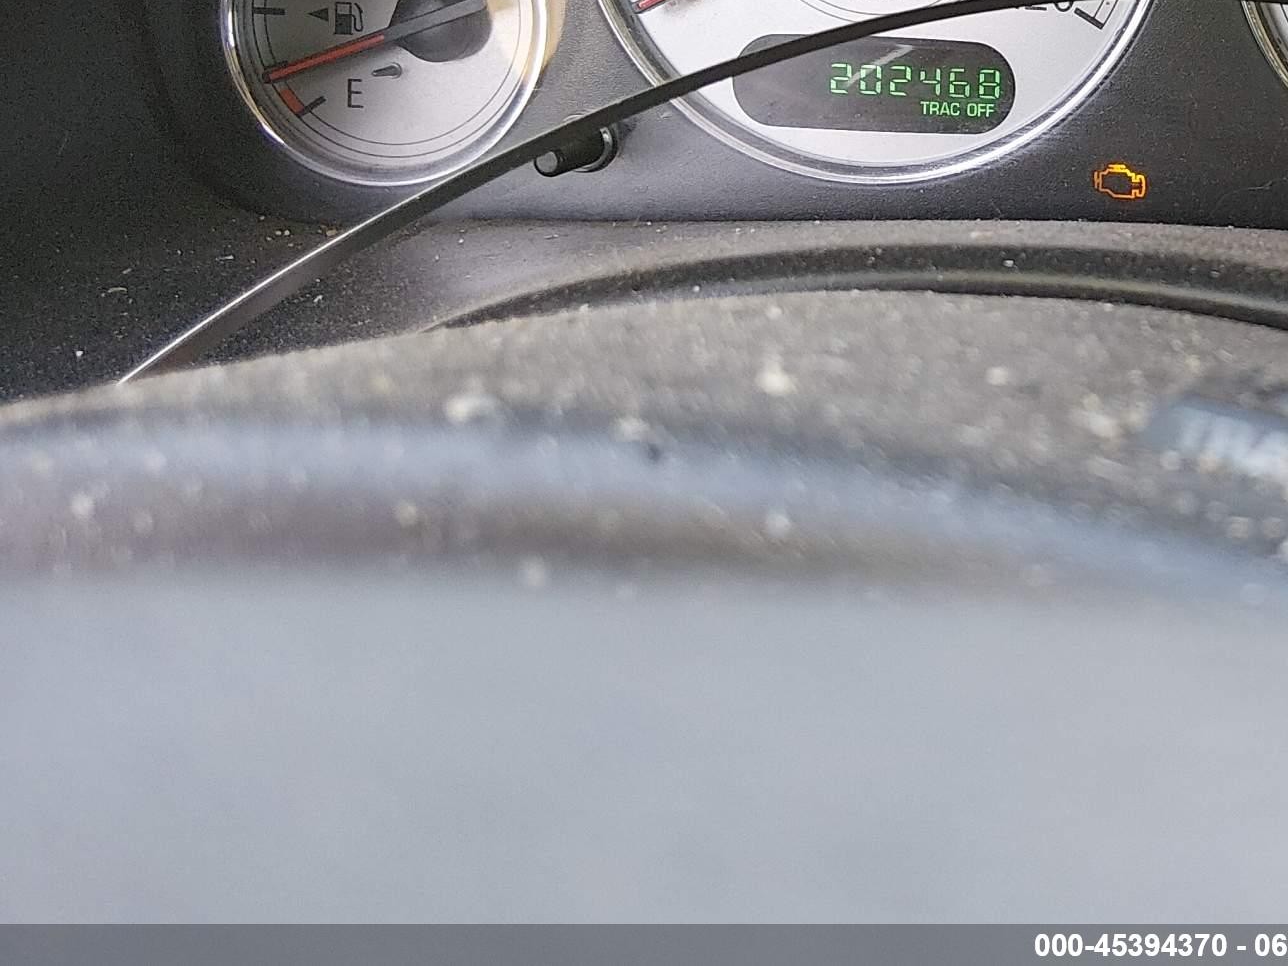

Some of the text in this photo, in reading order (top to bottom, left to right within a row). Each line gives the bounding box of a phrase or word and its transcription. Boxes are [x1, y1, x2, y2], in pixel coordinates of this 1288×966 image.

[347, 78, 364, 109] E
[829, 62, 1001, 100] 202468
[920, 100, 995, 118] TRAC OFF
